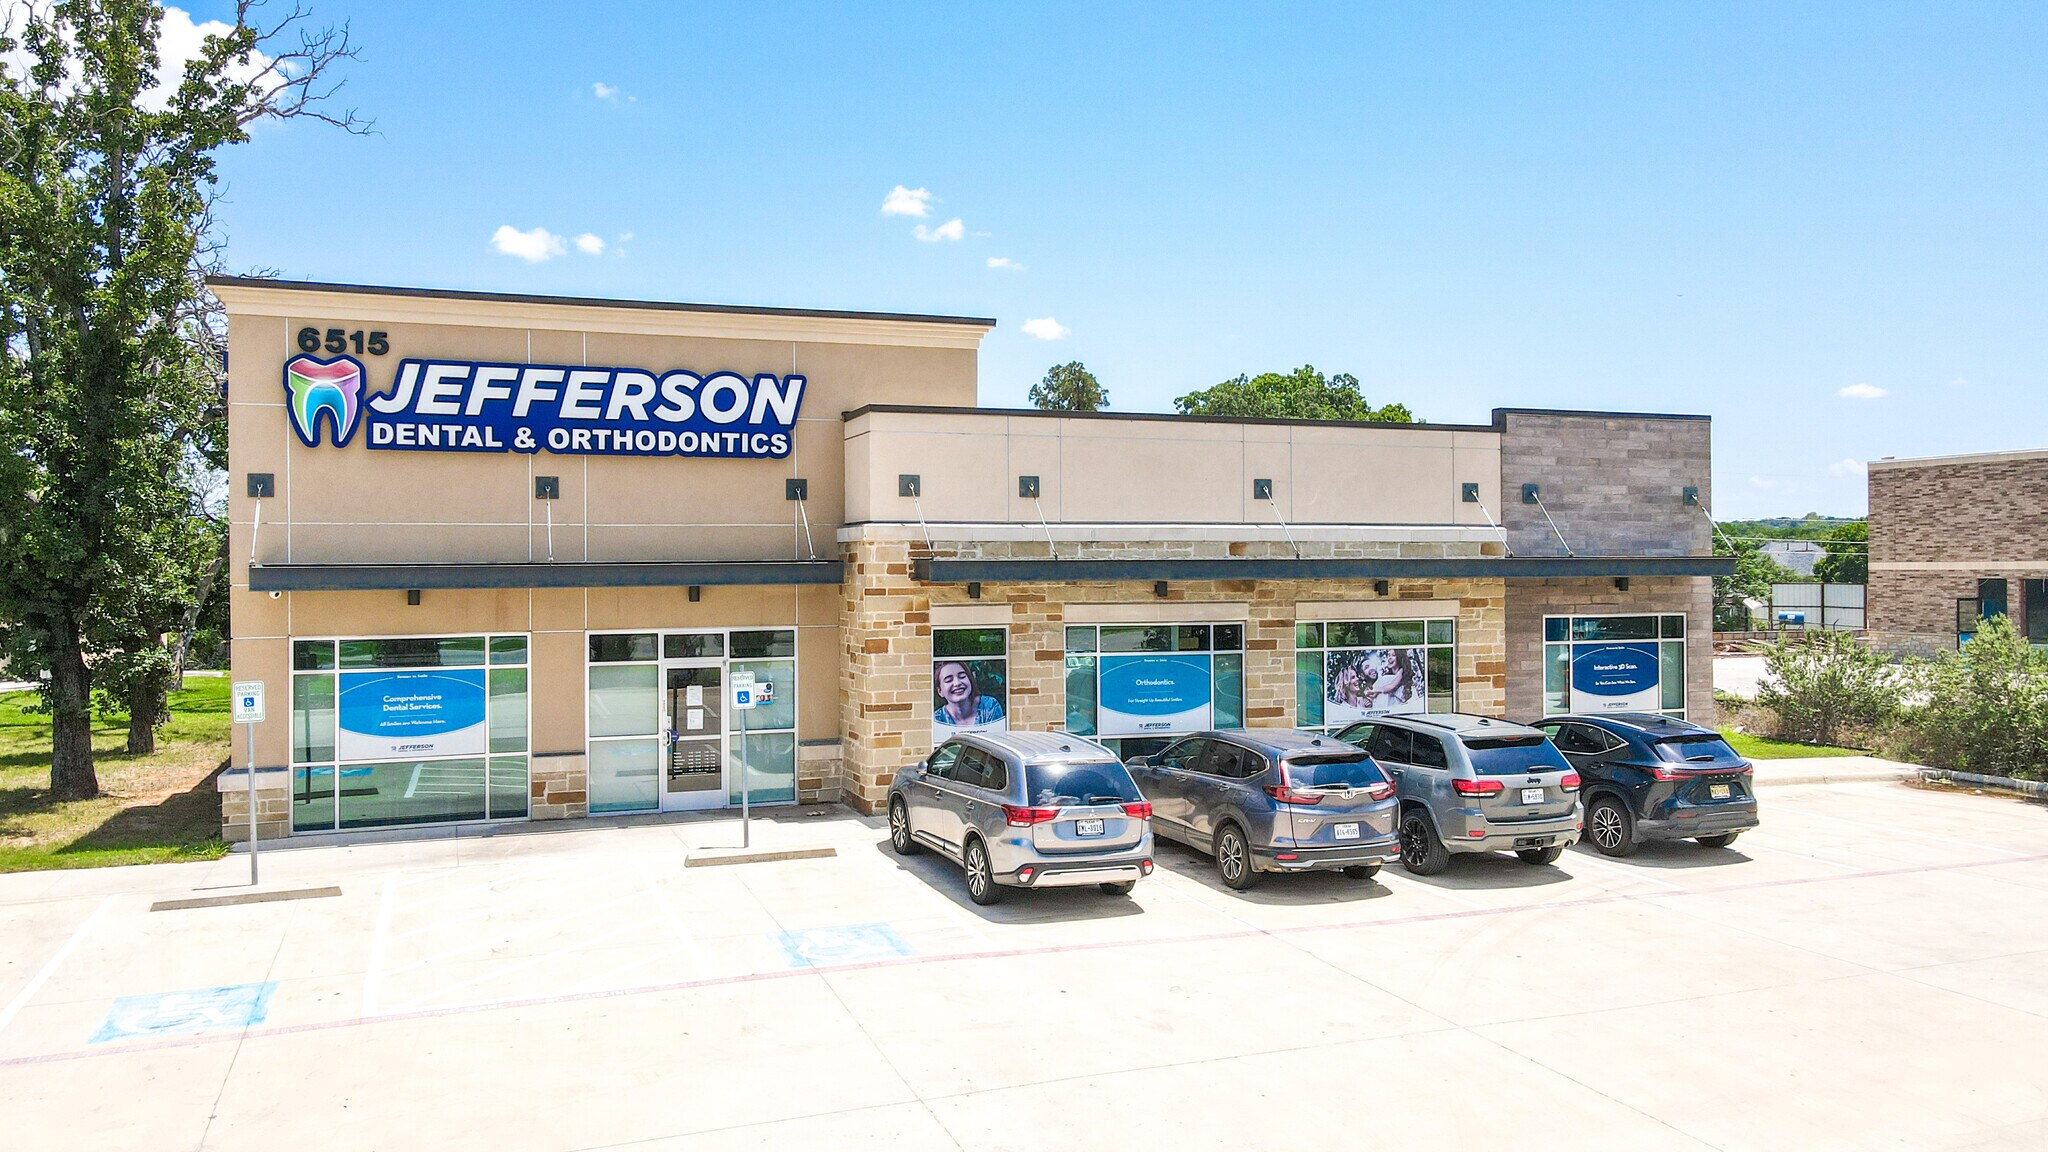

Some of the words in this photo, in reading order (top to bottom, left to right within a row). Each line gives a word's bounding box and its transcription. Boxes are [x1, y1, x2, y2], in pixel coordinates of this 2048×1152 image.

[297, 327, 390, 355] 6515
[369, 363, 803, 425] JEFFERSON
[372, 422, 503, 448] DENTAL
[514, 427, 537, 449] &
[548, 428, 788, 454] ORTHODONTICS
[1135, 678, 1175, 686] Orthodontics.
[383, 694, 442, 703] Comprehensive
[409, 703, 442, 711] Services.
